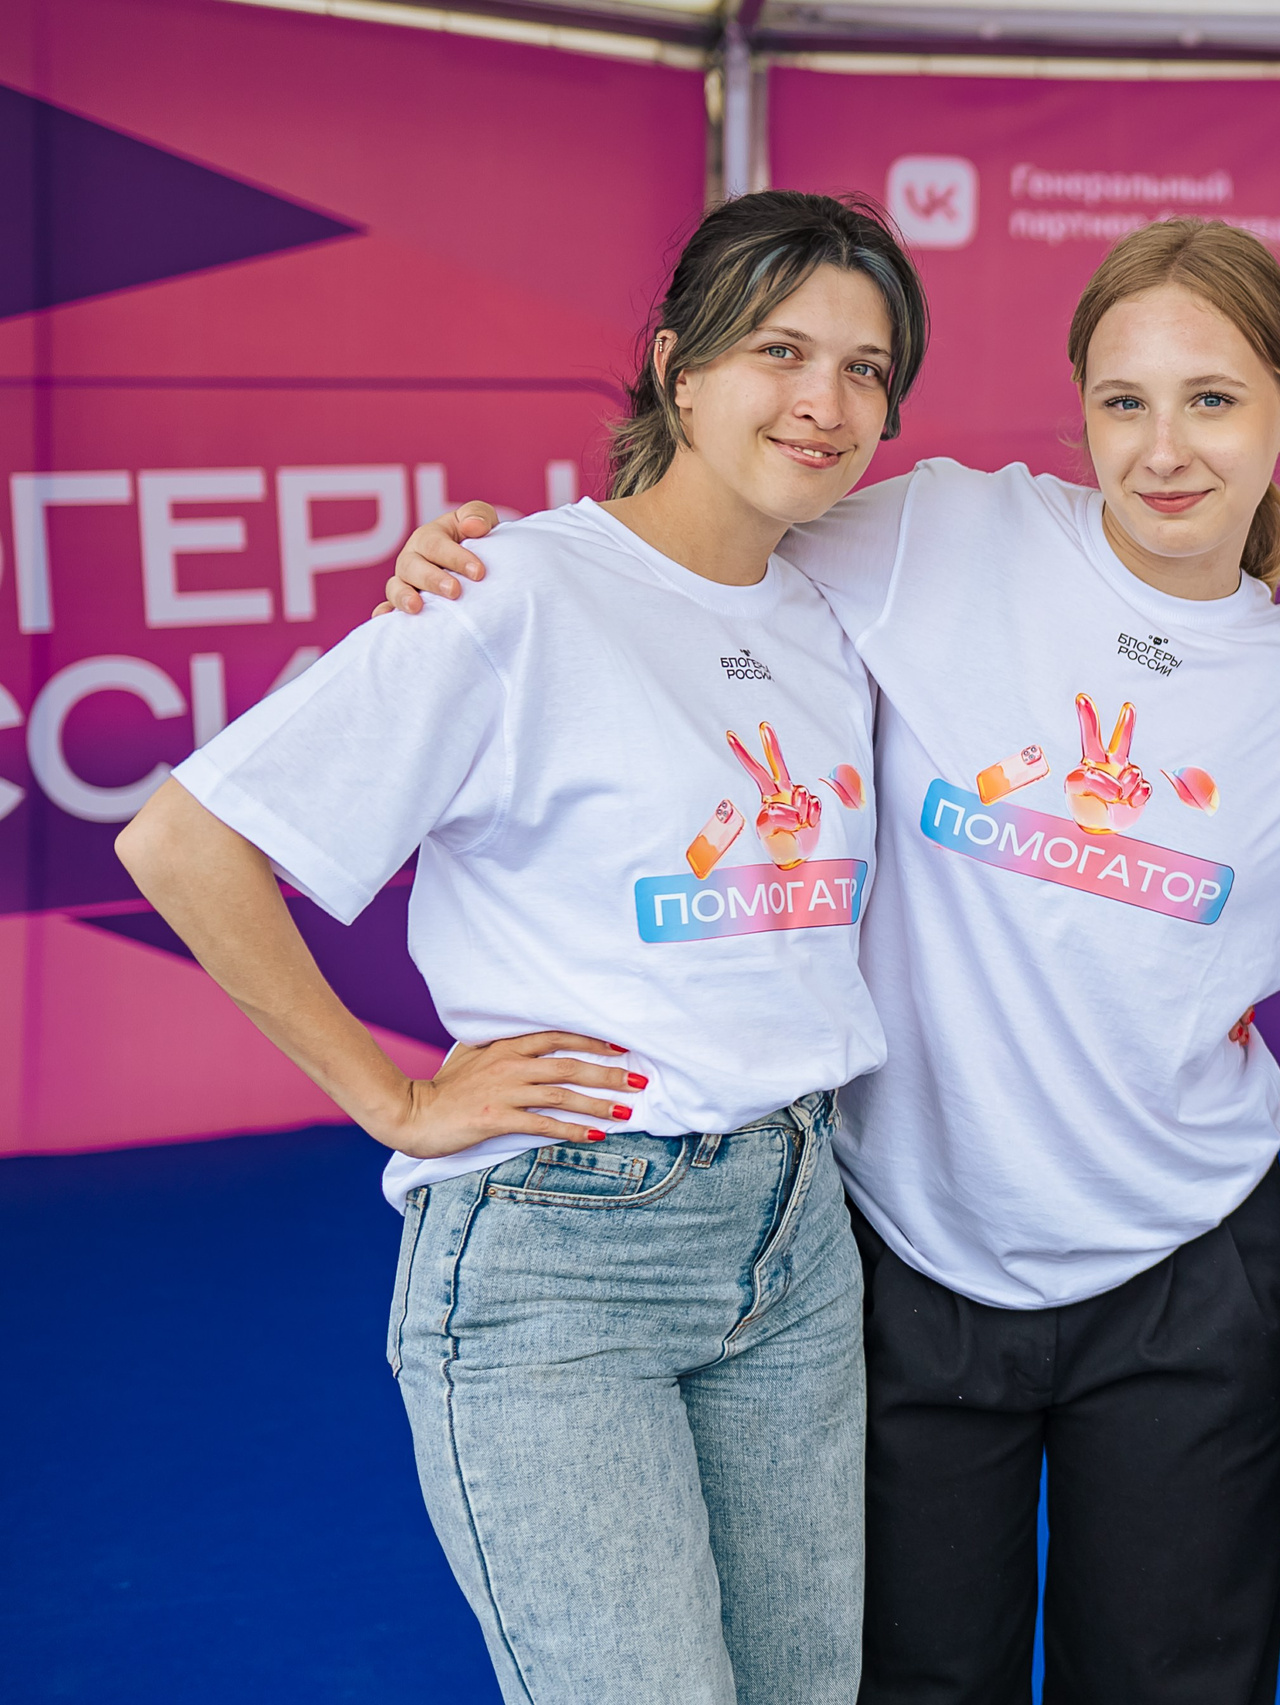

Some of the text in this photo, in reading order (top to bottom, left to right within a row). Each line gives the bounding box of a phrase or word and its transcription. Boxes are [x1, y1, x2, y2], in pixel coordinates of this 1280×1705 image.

[1117, 632, 1183, 669] БЛОГЕРЫ
[1117, 645, 1173, 677] РОССИИ
[933, 797, 1222, 908] ПОМОГАТОР
